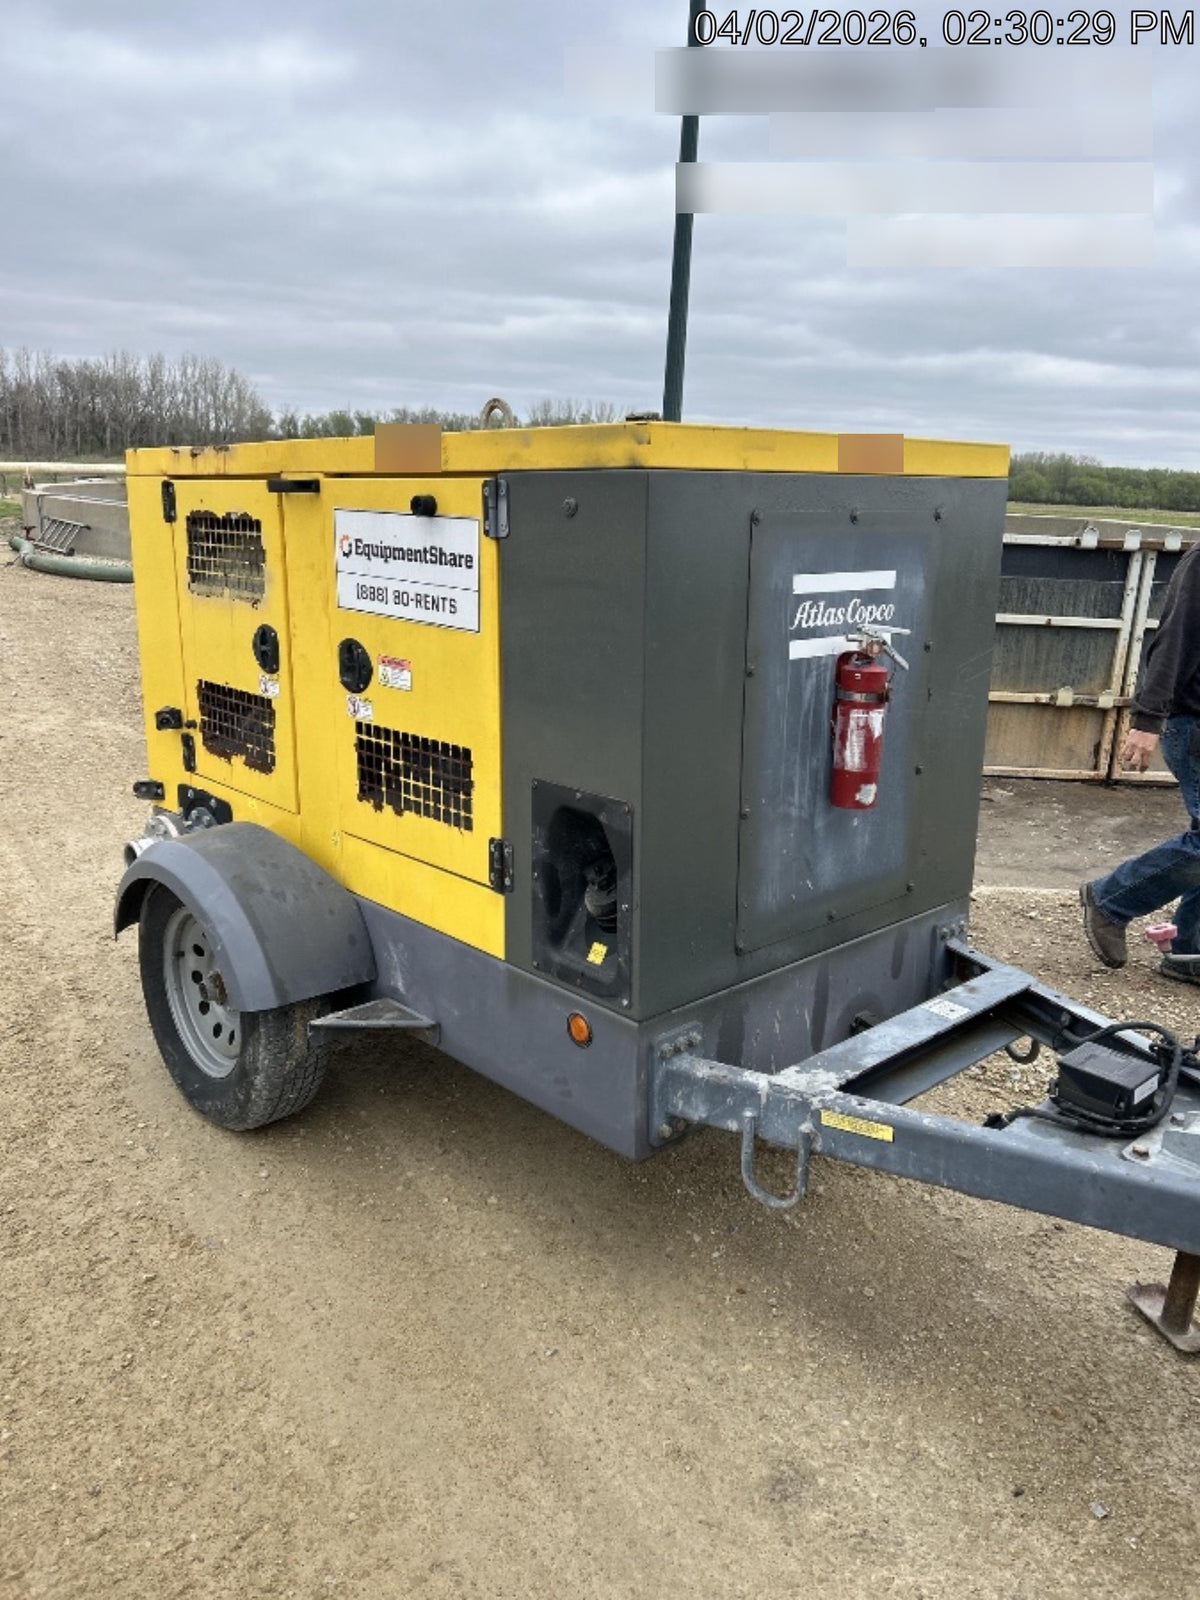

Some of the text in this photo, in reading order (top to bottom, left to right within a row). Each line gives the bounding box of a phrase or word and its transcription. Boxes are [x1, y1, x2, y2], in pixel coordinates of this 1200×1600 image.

[354, 538, 474, 569] EquipmentShare
[789, 598, 896, 630] Atlas Copco
